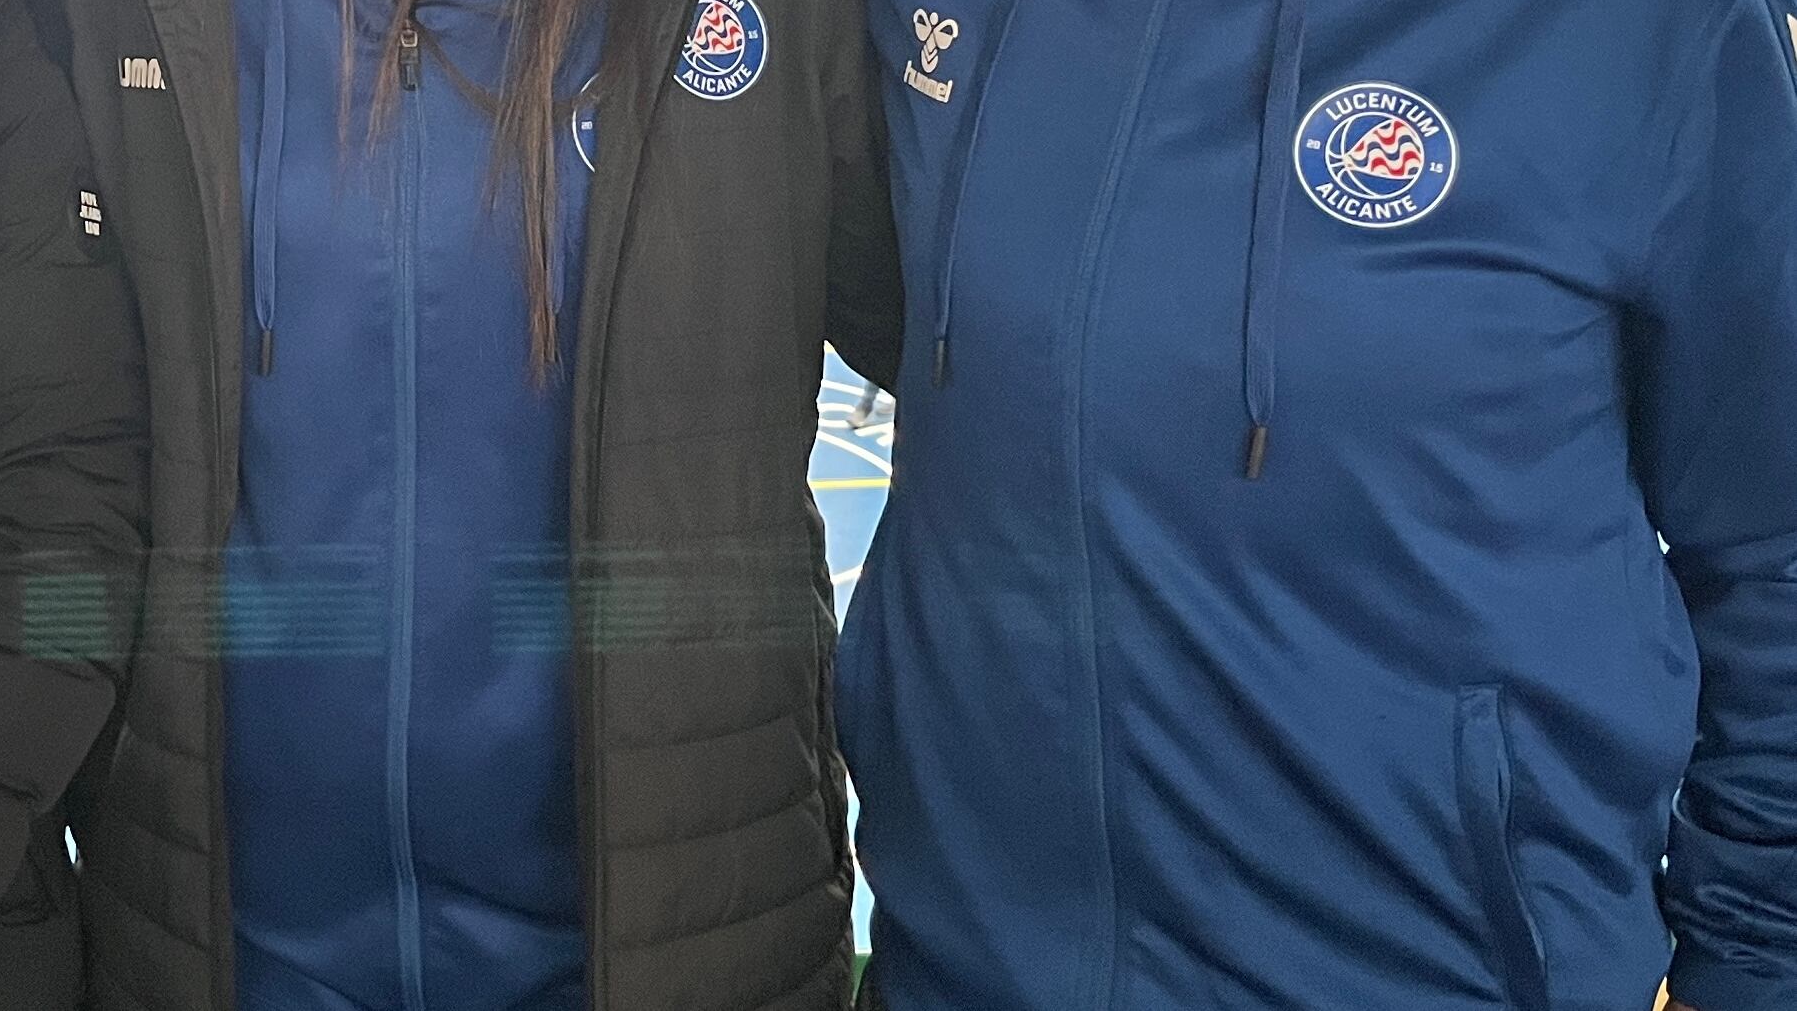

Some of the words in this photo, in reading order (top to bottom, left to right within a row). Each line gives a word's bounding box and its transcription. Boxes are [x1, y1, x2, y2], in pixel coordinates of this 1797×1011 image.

[682, 63, 753, 93] ALICANTE
[1325, 92, 1440, 137] LUCENTUM
[1305, 139, 1321, 150] 20
[1429, 161, 1444, 173] 15
[1315, 182, 1418, 220] ALICANTE
